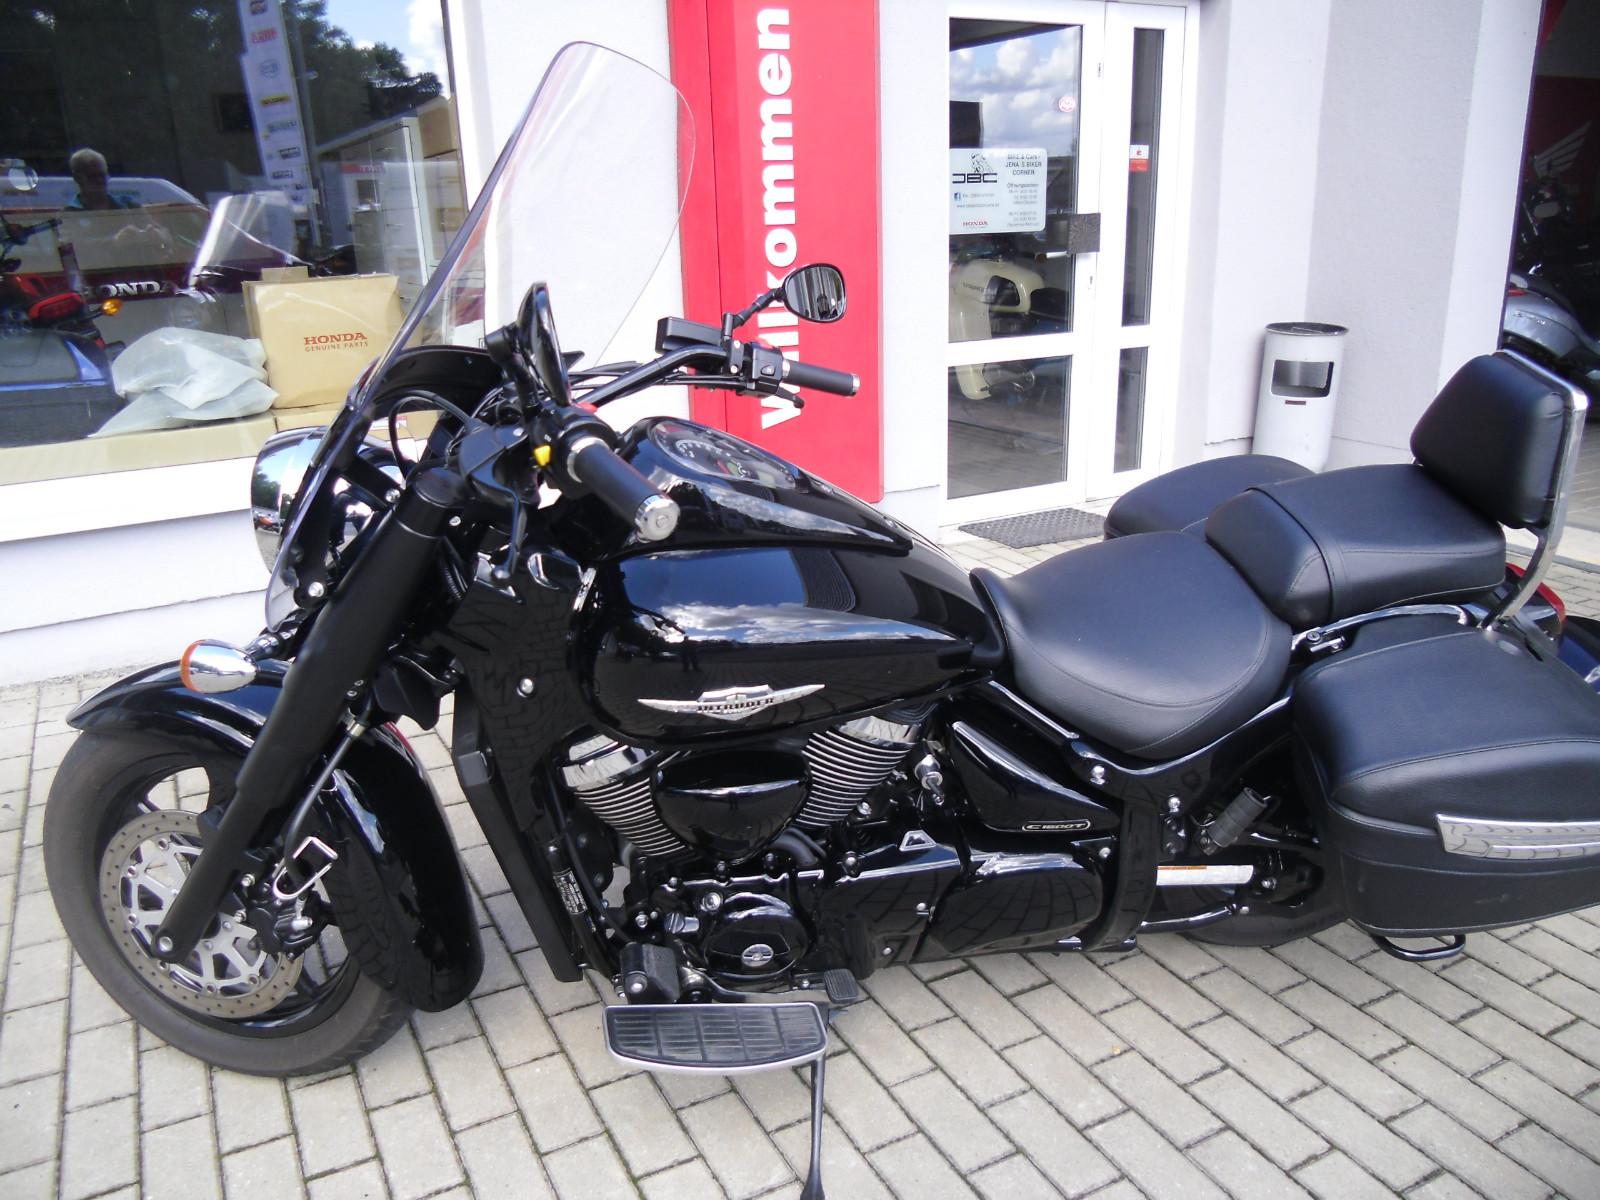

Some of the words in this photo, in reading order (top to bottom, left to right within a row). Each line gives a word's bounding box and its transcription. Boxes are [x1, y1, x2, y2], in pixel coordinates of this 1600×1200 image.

[303, 332, 368, 345] HONDA
[304, 343, 340, 352] GENUINE
[344, 341, 369, 349] PARTS
